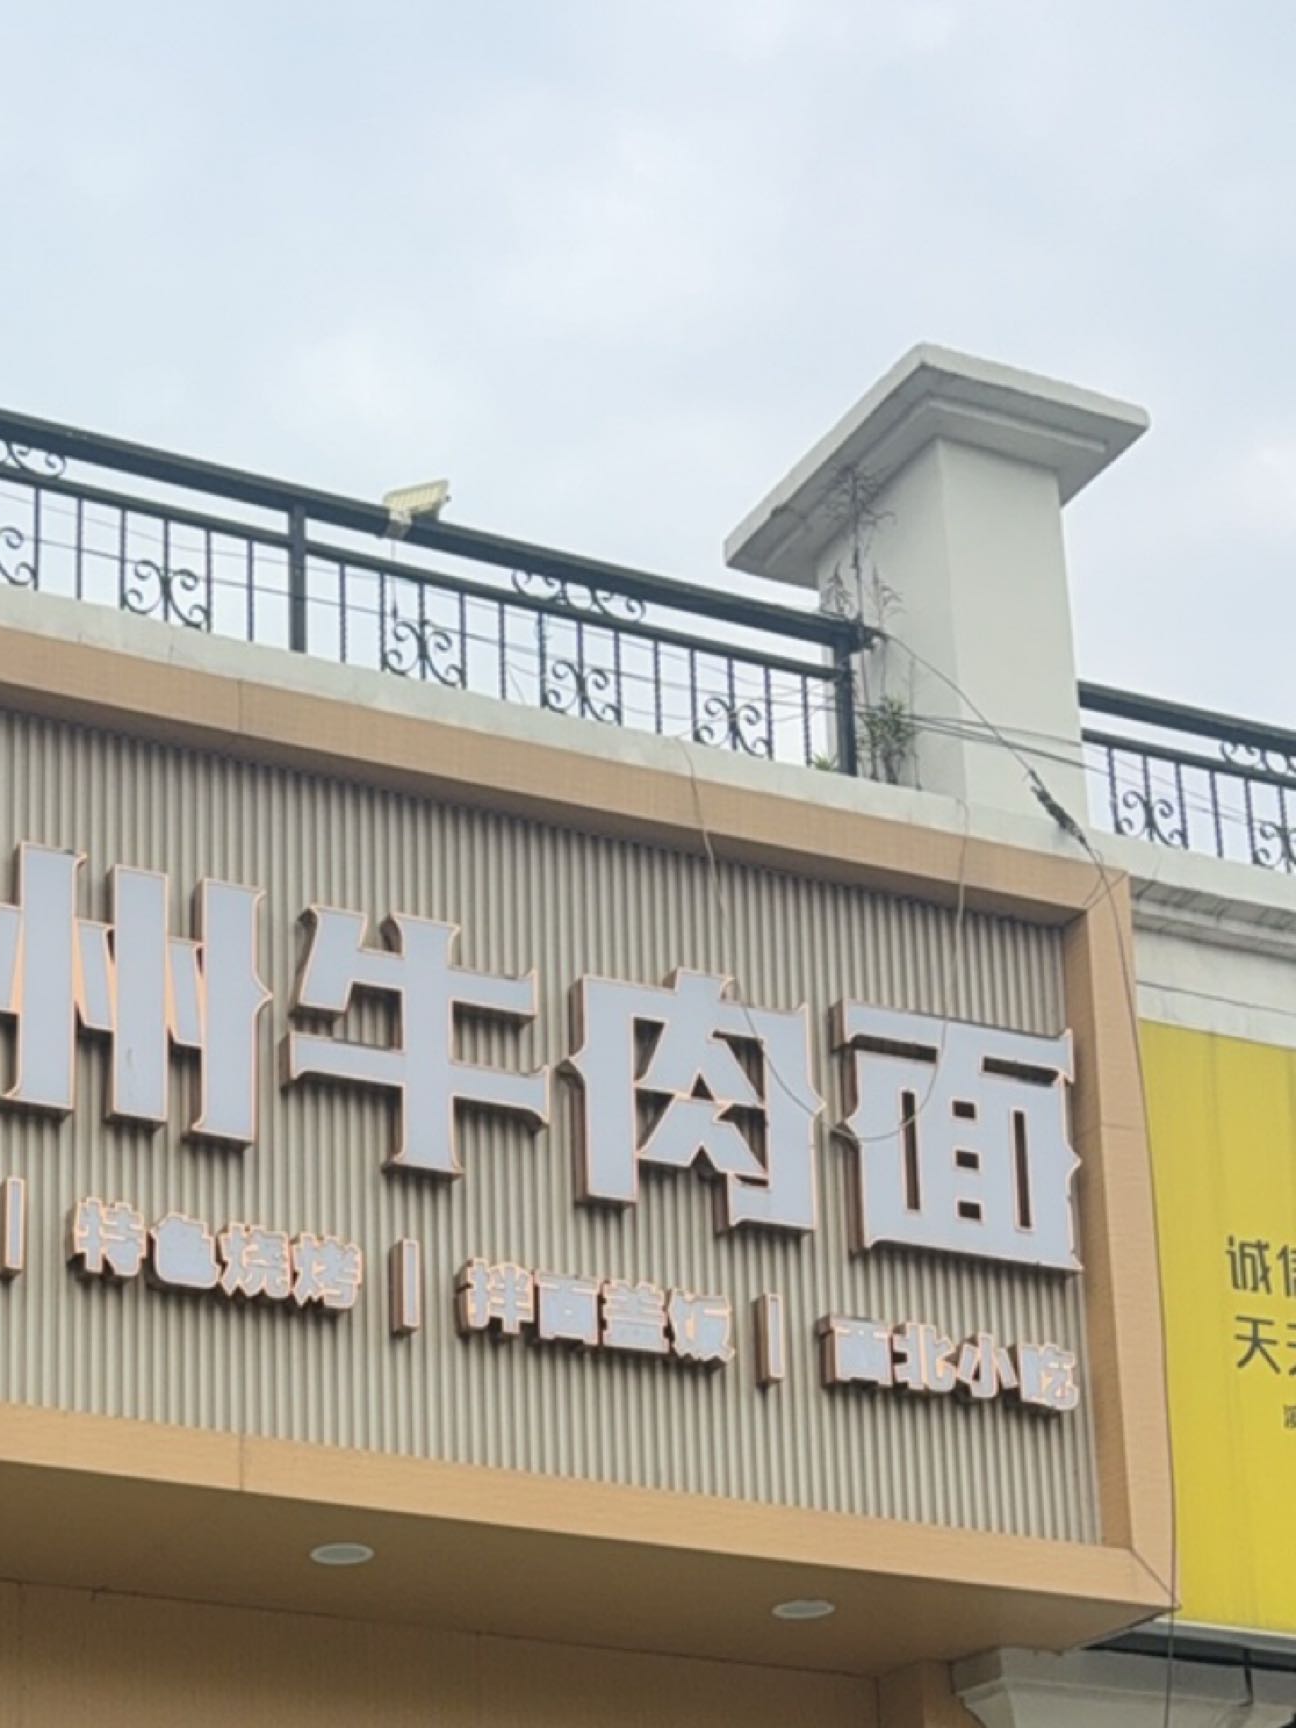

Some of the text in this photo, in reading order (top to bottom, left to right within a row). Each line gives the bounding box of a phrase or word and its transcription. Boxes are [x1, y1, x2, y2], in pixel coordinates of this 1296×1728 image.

[73, 1196, 362, 1310] 特色烧烤
[467, 1257, 735, 1363] 拌面盖饭
[826, 1313, 1079, 1411] 西北小吃
[1233, 1314, 1296, 1377] 天
